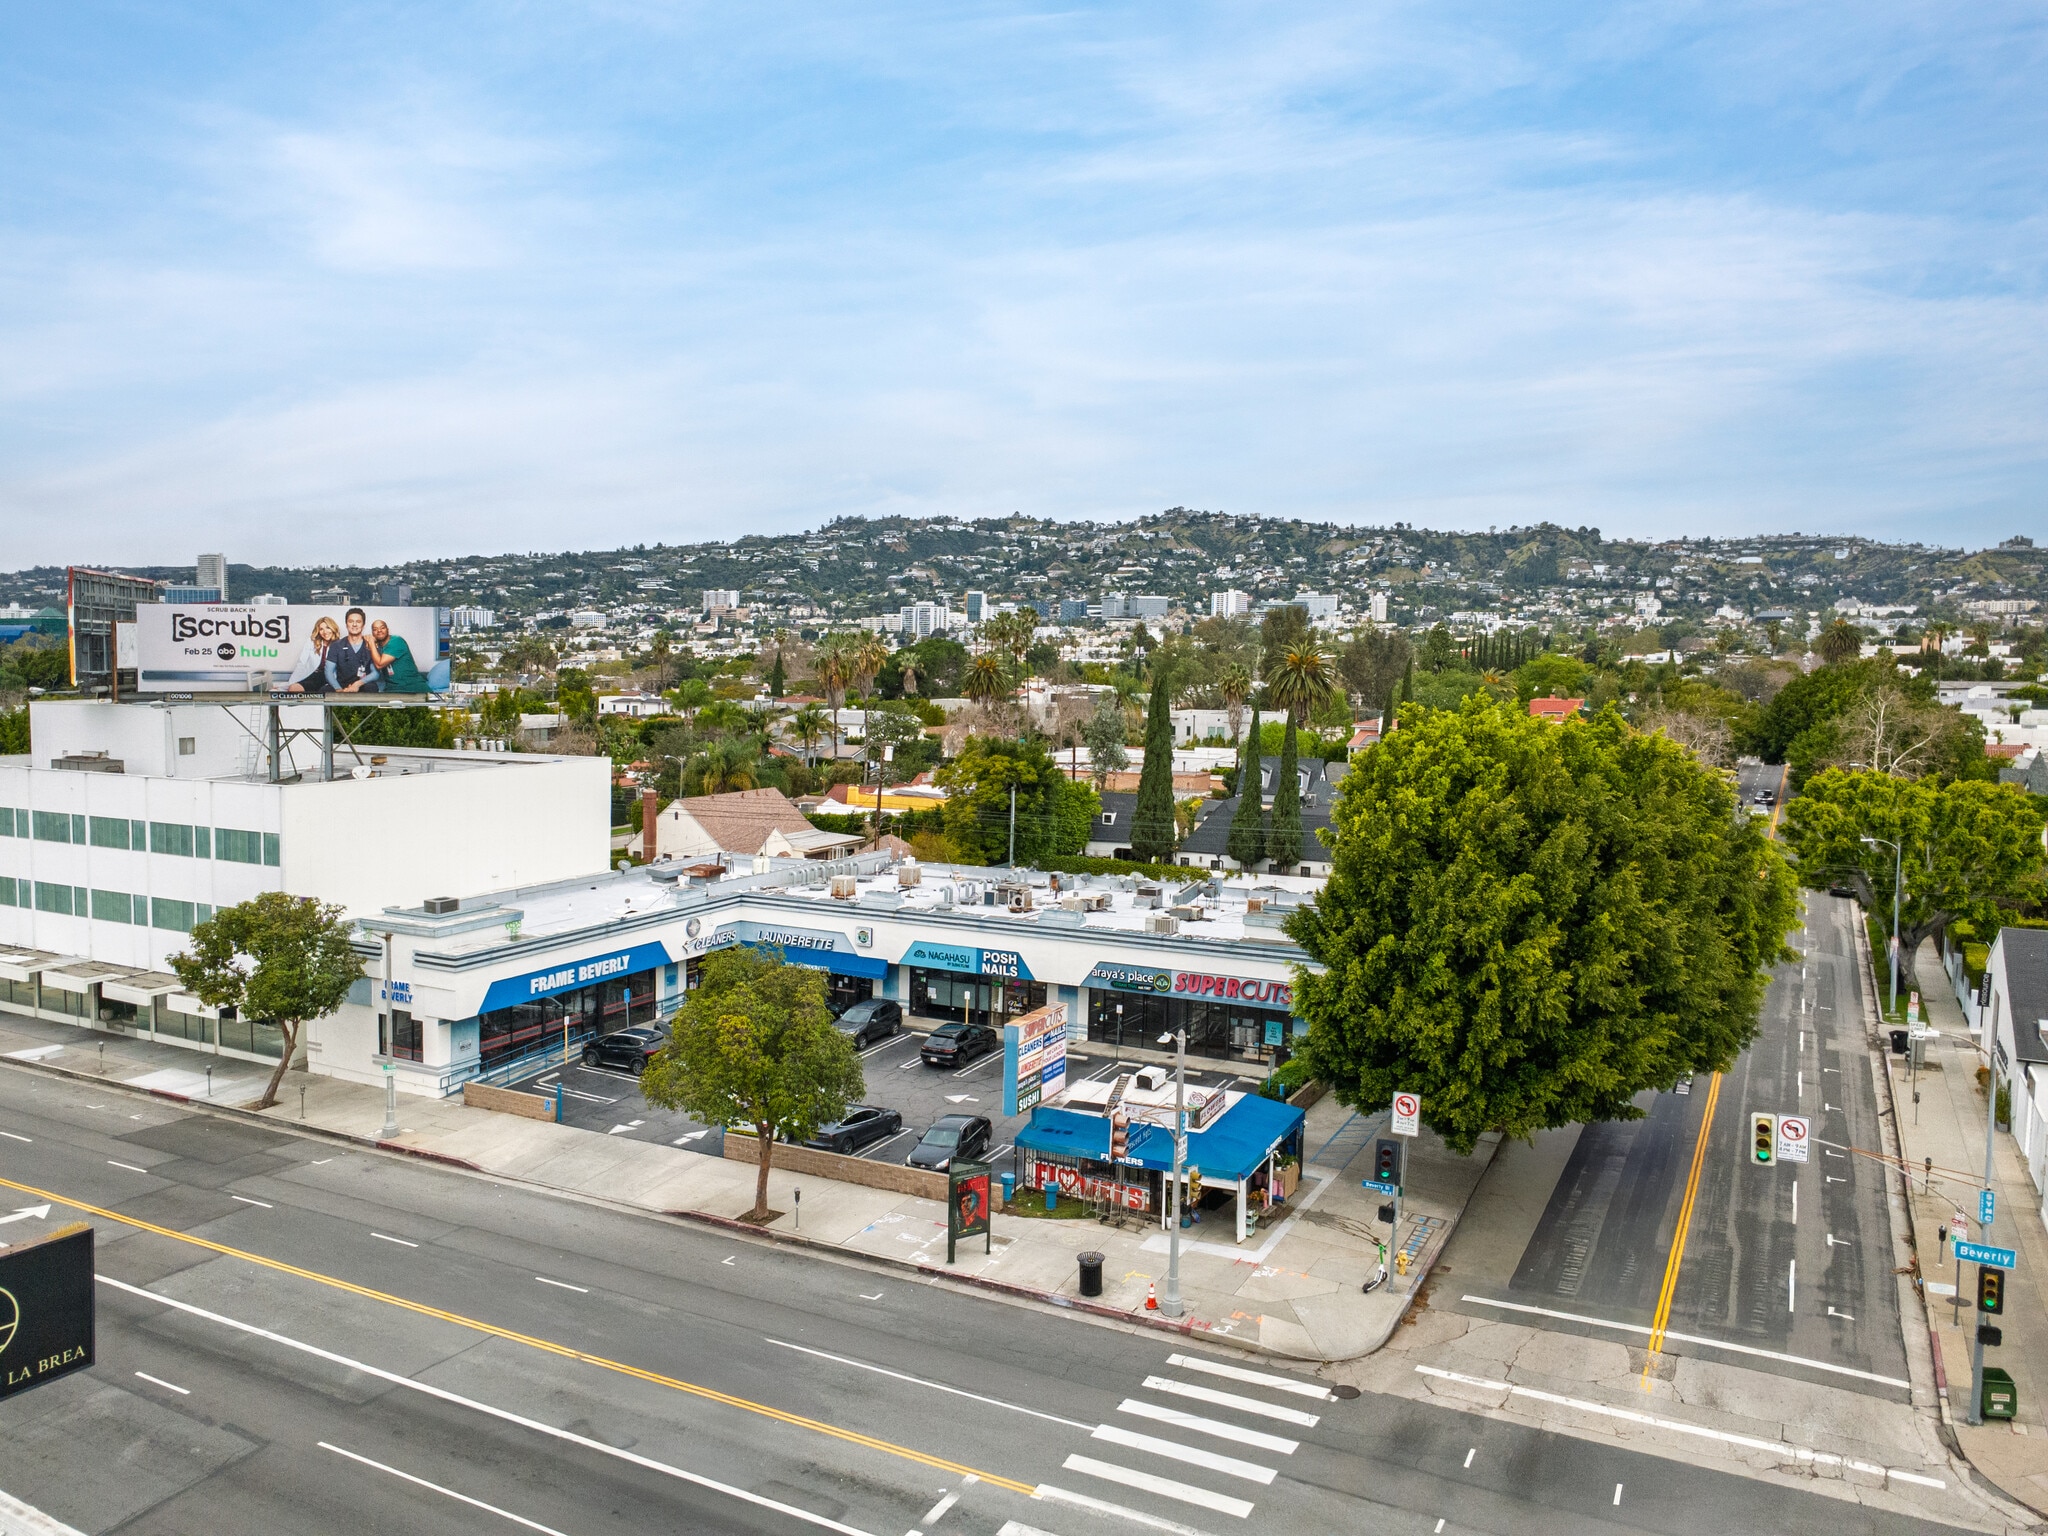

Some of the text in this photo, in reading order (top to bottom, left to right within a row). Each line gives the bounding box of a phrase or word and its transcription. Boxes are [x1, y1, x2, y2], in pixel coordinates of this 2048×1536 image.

[184, 647, 200, 655] Feb
[240, 645, 278, 657] hulu
[695, 930, 737, 950] CLEANERS
[757, 930, 834, 950] LAUNDERETTE
[928, 950, 970, 964] NAGAHASU
[983, 951, 1017, 965] POSH
[530, 954, 631, 994] FRAME BEVERLY
[982, 963, 1018, 977] NAILS
[1091, 968, 1154, 983] araya's place
[381, 989, 413, 1003] BVERLY
[1175, 973, 1293, 1005] SUPERCUTS
[1018, 1037, 1042, 1056] CLEANERS
[1018, 1090, 1040, 1112] SUSHI
[1100, 1152, 1143, 1166] FLWERS
[1960, 1246, 2010, 1265] Beverly
[7, 1345, 85, 1385] LA BREA
